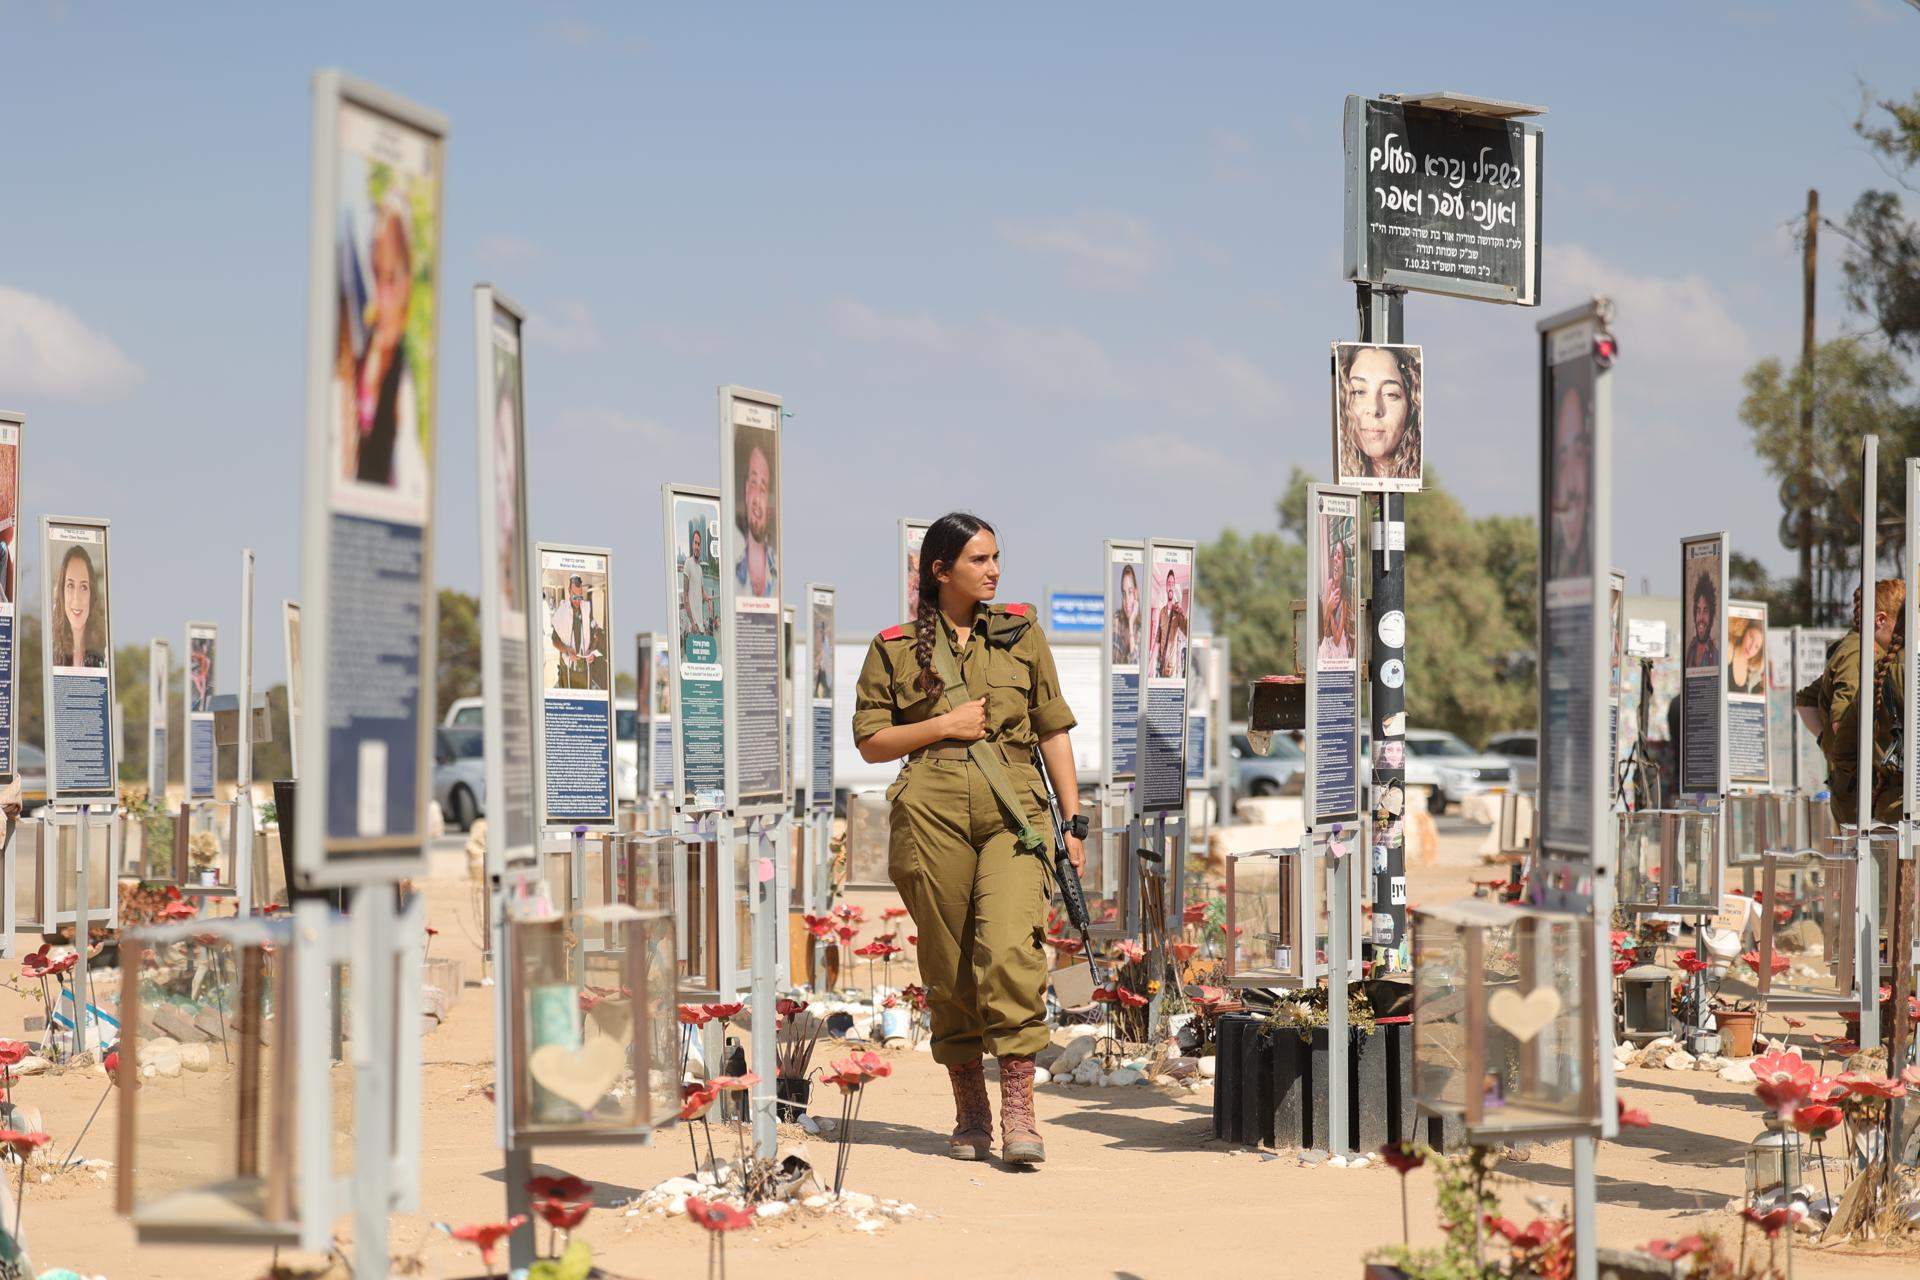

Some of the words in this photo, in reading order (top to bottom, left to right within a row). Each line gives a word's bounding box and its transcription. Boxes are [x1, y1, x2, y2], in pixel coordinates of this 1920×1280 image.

[1370, 133, 1417, 174] העולם
[1425, 153, 1465, 189] נברא
[1473, 147, 1521, 189] בשבילי
[1375, 185, 1422, 216] ואפר
[1428, 191, 1465, 220] עפר
[1471, 198, 1516, 231] ואנוכי
[1388, 225, 1411, 237] סנדרה
[1412, 228, 1428, 239] שרה
[1430, 230, 1441, 241] בת
[1443, 231, 1455, 242] אור
[1456, 232, 1476, 245] מוריה
[1477, 235, 1504, 248] הקדושה
[1416, 243, 1434, 256] תורה
[1435, 245, 1458, 257] שמחת
[1404, 257, 1430, 270] 7.10.23
[1457, 262, 1476, 275] תשרי
